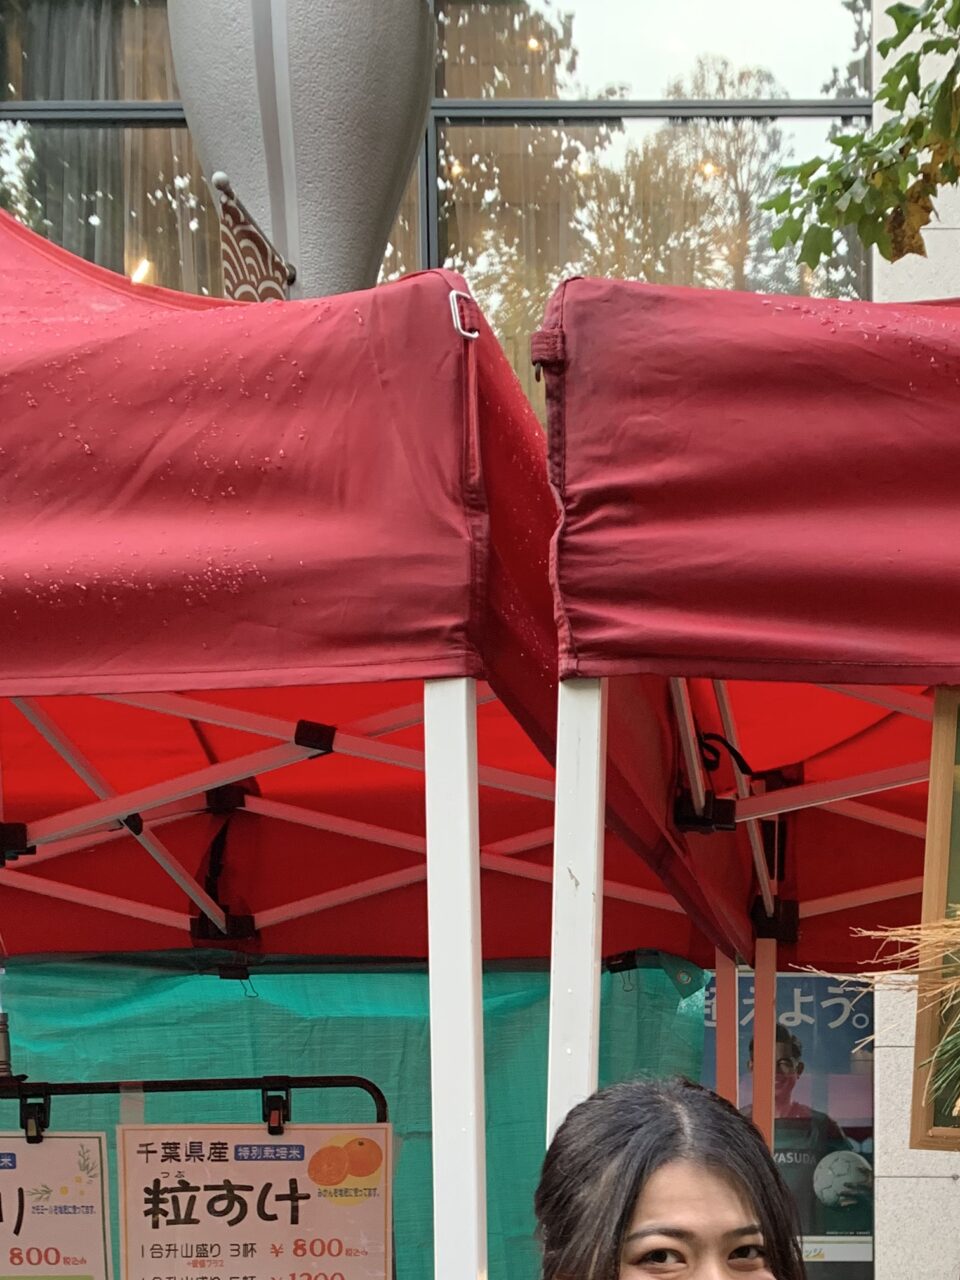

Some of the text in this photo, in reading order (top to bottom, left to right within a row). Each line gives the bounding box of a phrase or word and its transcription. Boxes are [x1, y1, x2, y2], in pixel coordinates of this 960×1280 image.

[136, 1141, 302, 1164] 千葉県産 特別栽培米
[160, 1170, 186, 1179] つぶ
[143, 1178, 312, 1230] 粒すけ
[9, 1246, 62, 1266] 800
[229, 1242, 257, 1258] 3杯
[292, 1238, 344, 1258] 800
